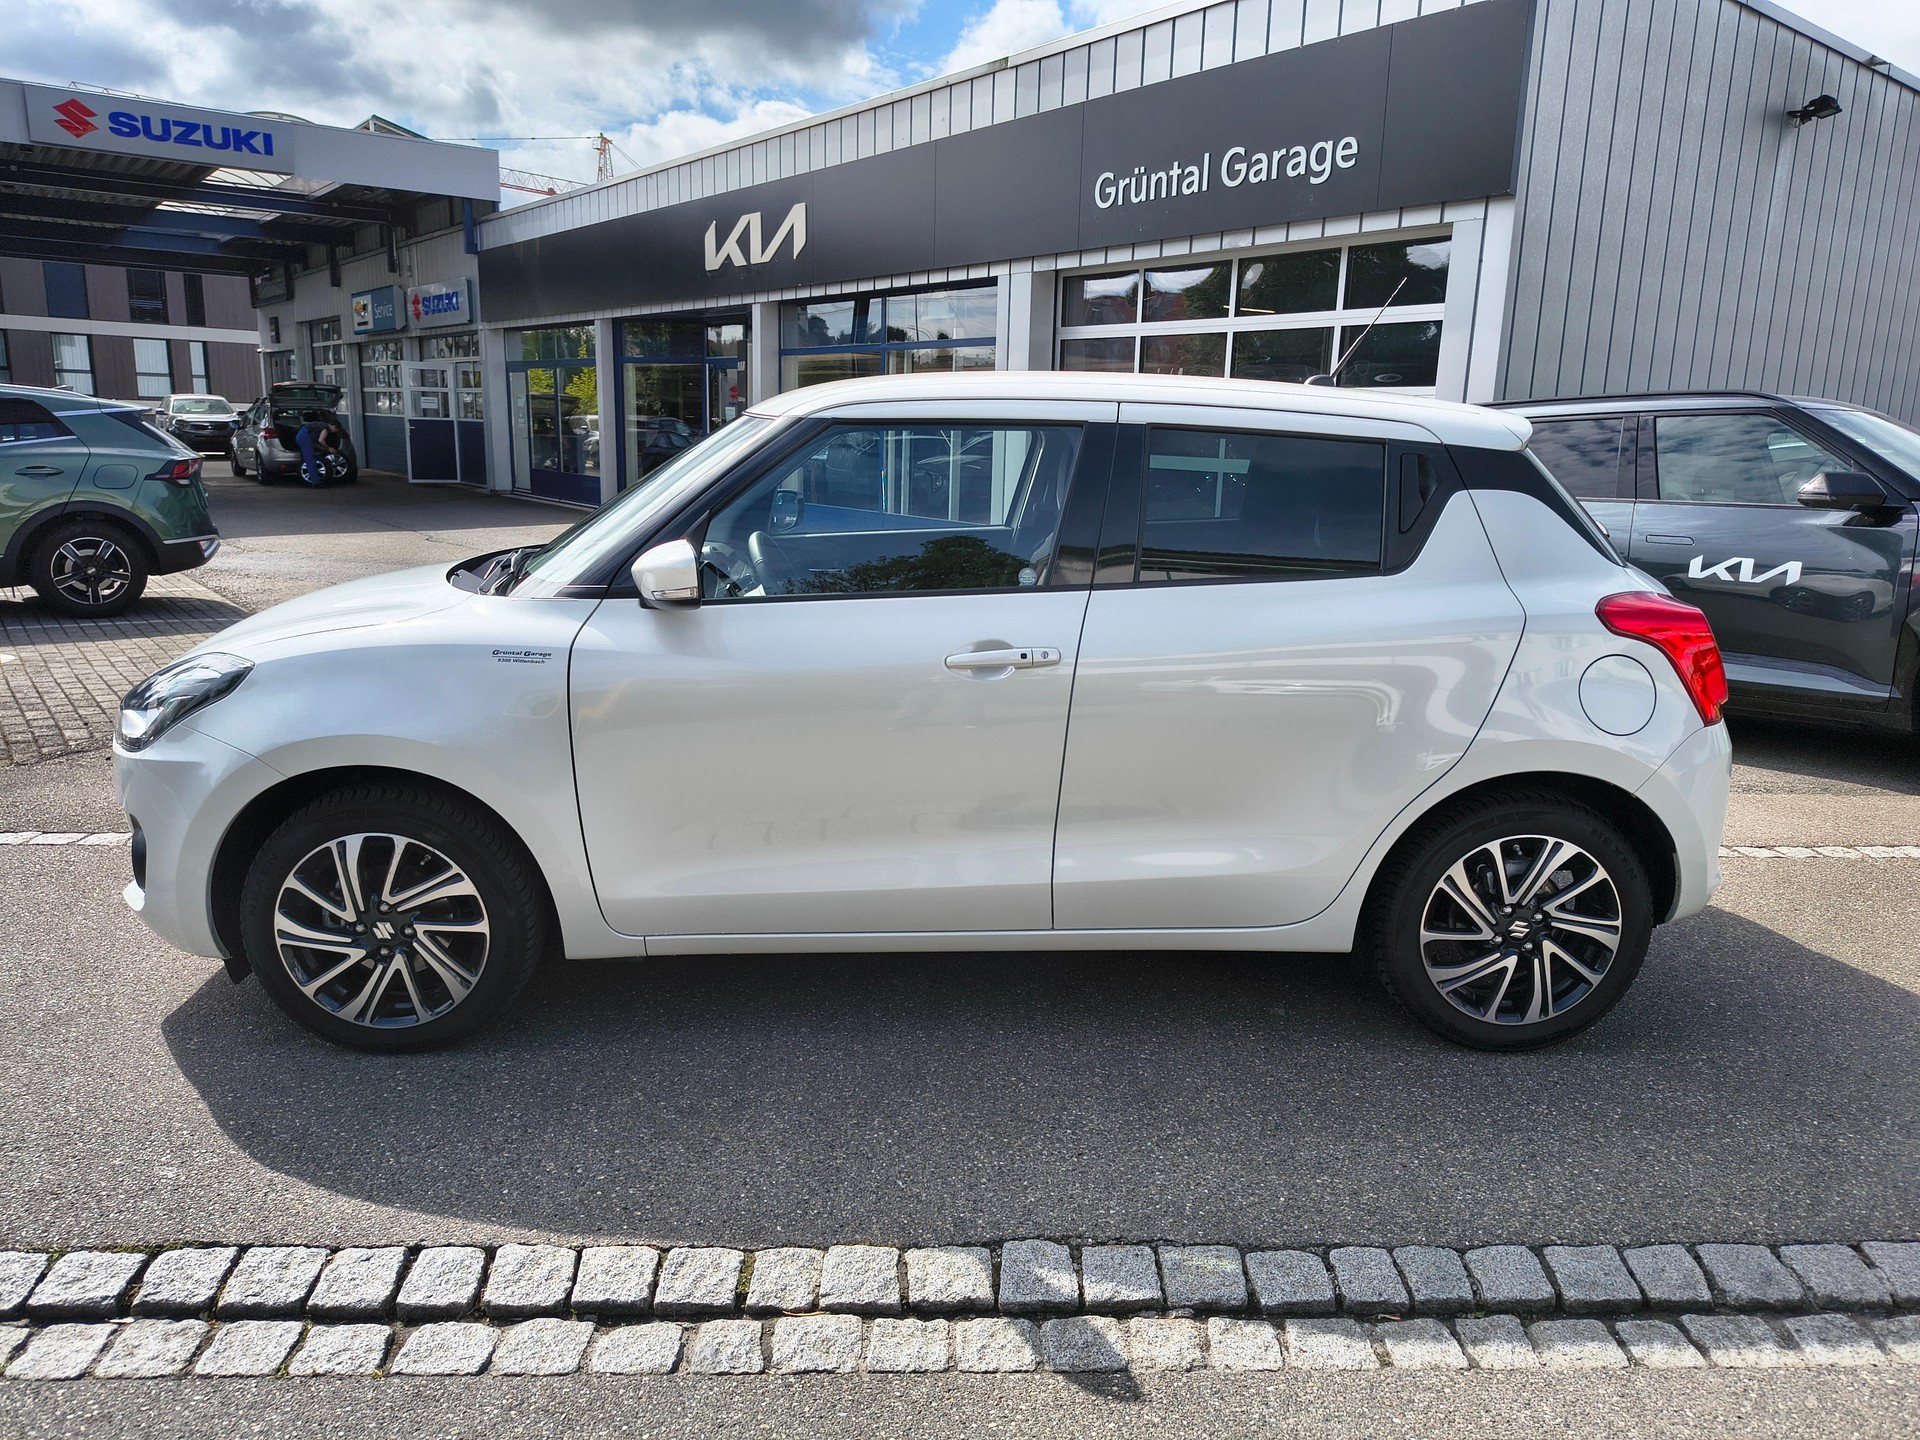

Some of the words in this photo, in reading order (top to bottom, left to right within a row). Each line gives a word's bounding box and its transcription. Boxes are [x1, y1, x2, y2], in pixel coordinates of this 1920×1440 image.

[108, 111, 274, 156] SUZUKI
[1094, 153, 1210, 209] Grüntal
[1220, 136, 1359, 184] Garage
[704, 202, 807, 271] KIA
[374, 301, 393, 319] Service
[1688, 554, 1803, 586] KIA
